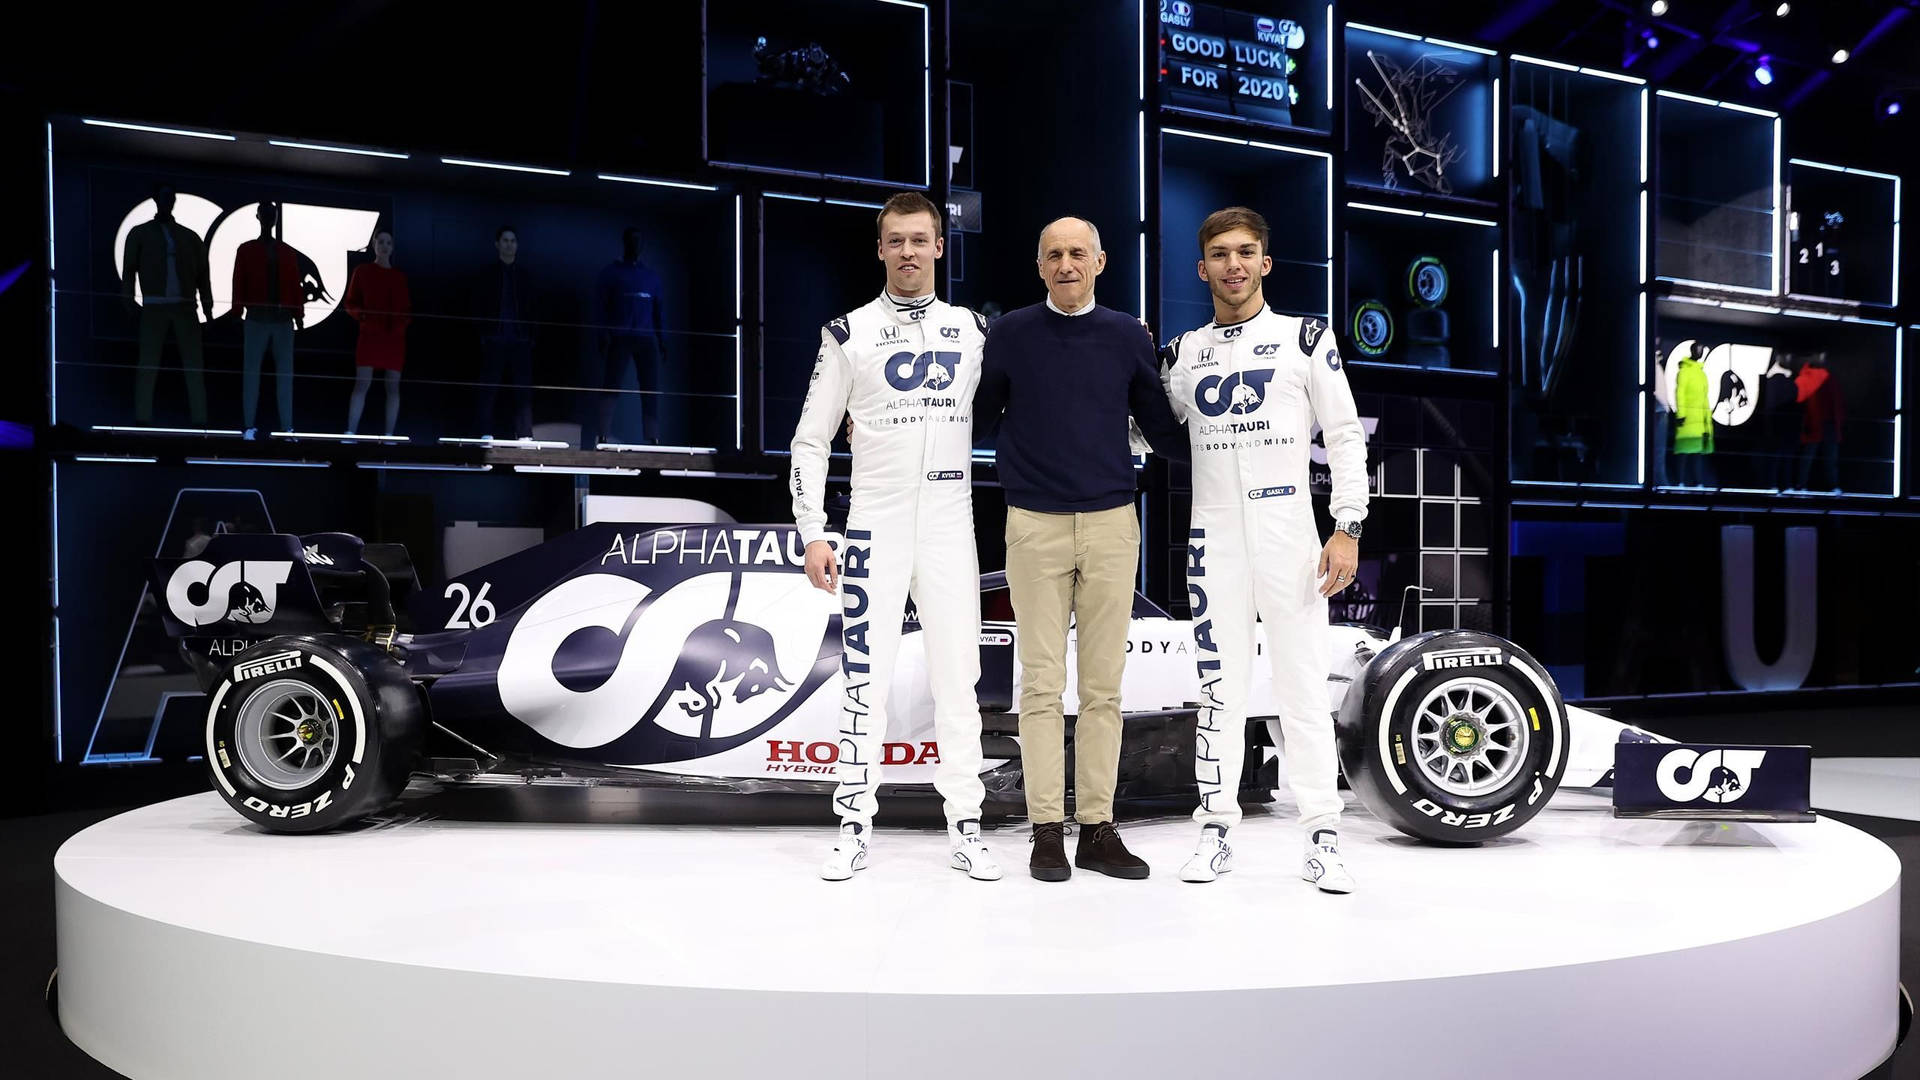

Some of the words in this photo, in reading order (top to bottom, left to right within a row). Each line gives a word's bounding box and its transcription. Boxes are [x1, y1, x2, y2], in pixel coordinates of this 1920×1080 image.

[1160, 11, 1190, 27] GASLY
[1172, 34, 1224, 59] GOOD
[1235, 46, 1282, 69] LUCK
[1257, 31, 1286, 45] KVYAT
[1181, 66, 1218, 89] FOR
[1238, 76, 1283, 101] 2020
[1799, 248, 1809, 264] 2
[1815, 242, 1823, 257] 1
[1830, 260, 1840, 275] 3
[875, 338, 910, 347] HONDA
[1191, 361, 1219, 370] HONDA
[1199, 420, 1271, 436] ALPHATAURI
[601, 529, 845, 566] ALPHATAUR
[444, 582, 496, 629] 26
[1720, 524, 1818, 690] U
[234, 650, 303, 683] PIRELLI
[836, 530, 872, 812] ALPHATAURI
[1188, 528, 1224, 812] ALPHATAURI
[1422, 647, 1503, 671] PIRELLI
[766, 740, 941, 765] HODA
[342, 764, 356, 790] P
[243, 790, 334, 819] ZERO
[1527, 778, 1544, 806] P
[1412, 798, 1517, 829] ZERO
